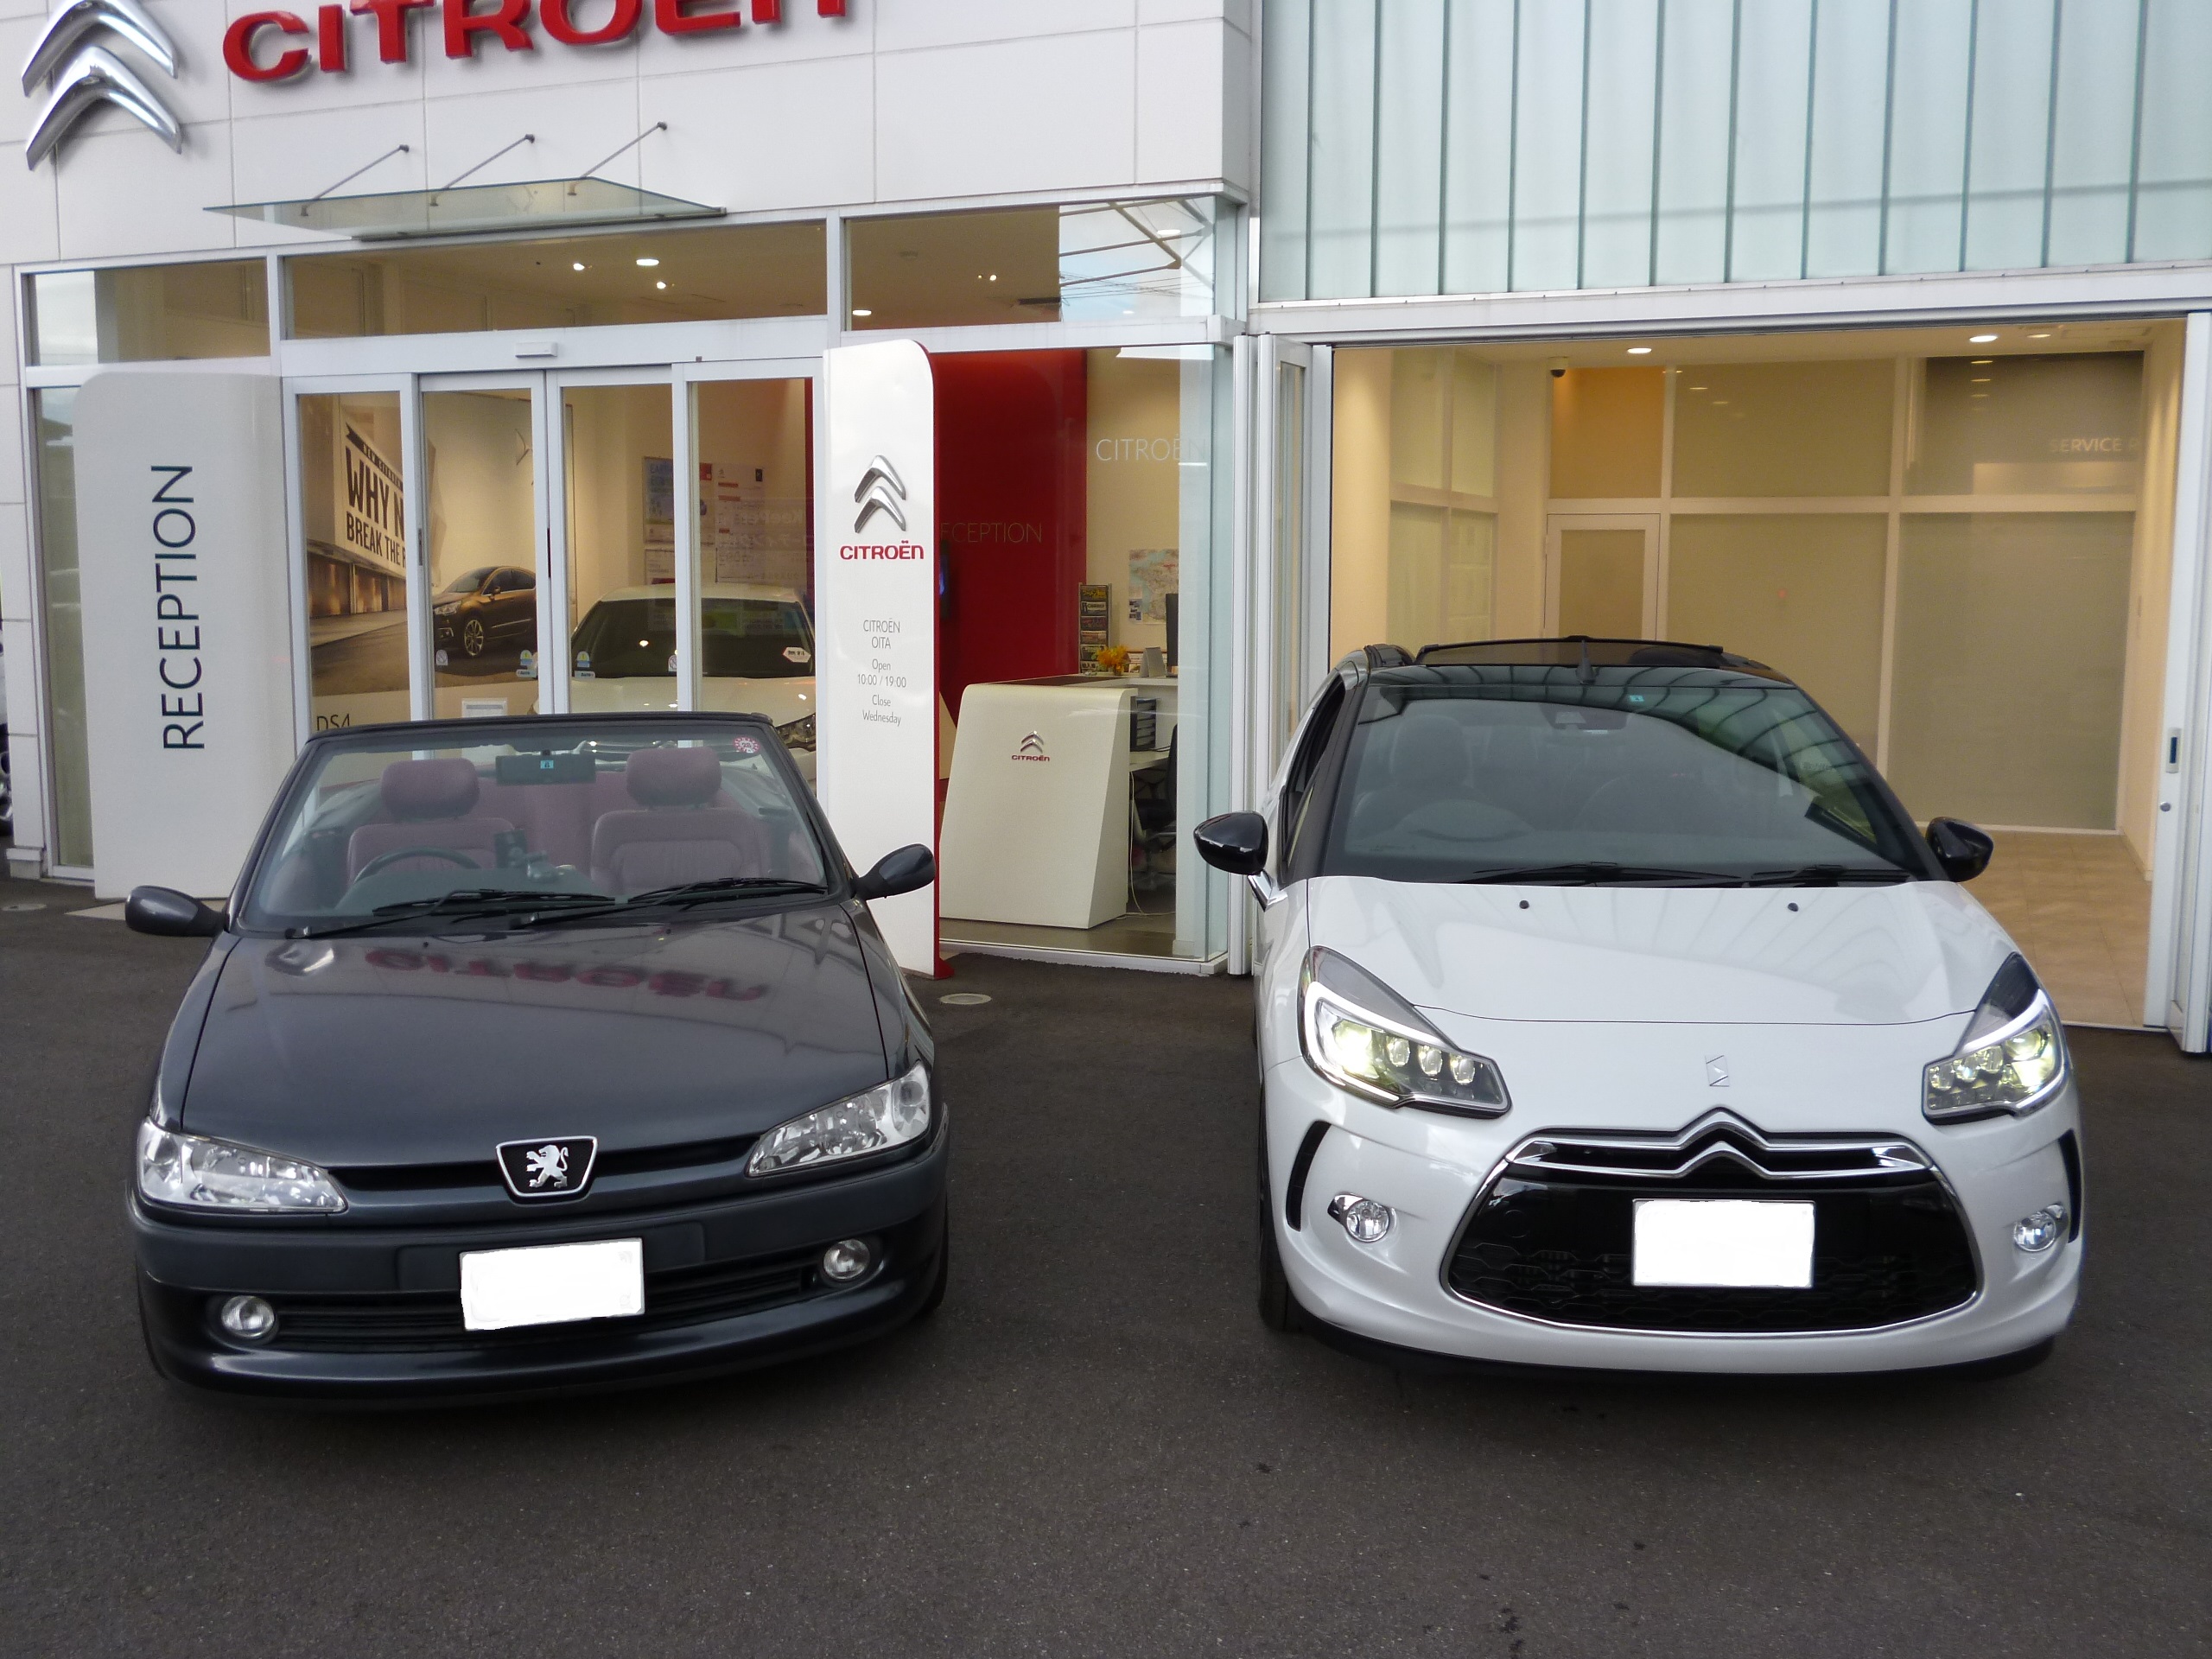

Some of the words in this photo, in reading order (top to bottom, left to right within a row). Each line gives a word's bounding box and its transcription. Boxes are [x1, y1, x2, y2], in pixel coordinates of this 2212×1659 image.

[222, 0, 846, 83] CITRO
[346, 445, 389, 531] WHY
[346, 511, 383, 557] BREAK
[385, 535, 401, 566] THE
[939, 521, 1042, 543] ECEPTION
[150, 465, 205, 749] RECEPTION
[863, 617, 900, 633] CITROËN
[871, 636, 892, 649] OITA
[872, 658, 892, 673] Open
[857, 673, 878, 686] 10:00
[885, 676, 907, 689] 19:00
[872, 694, 892, 707] Close
[862, 709, 901, 728] Wednesday
